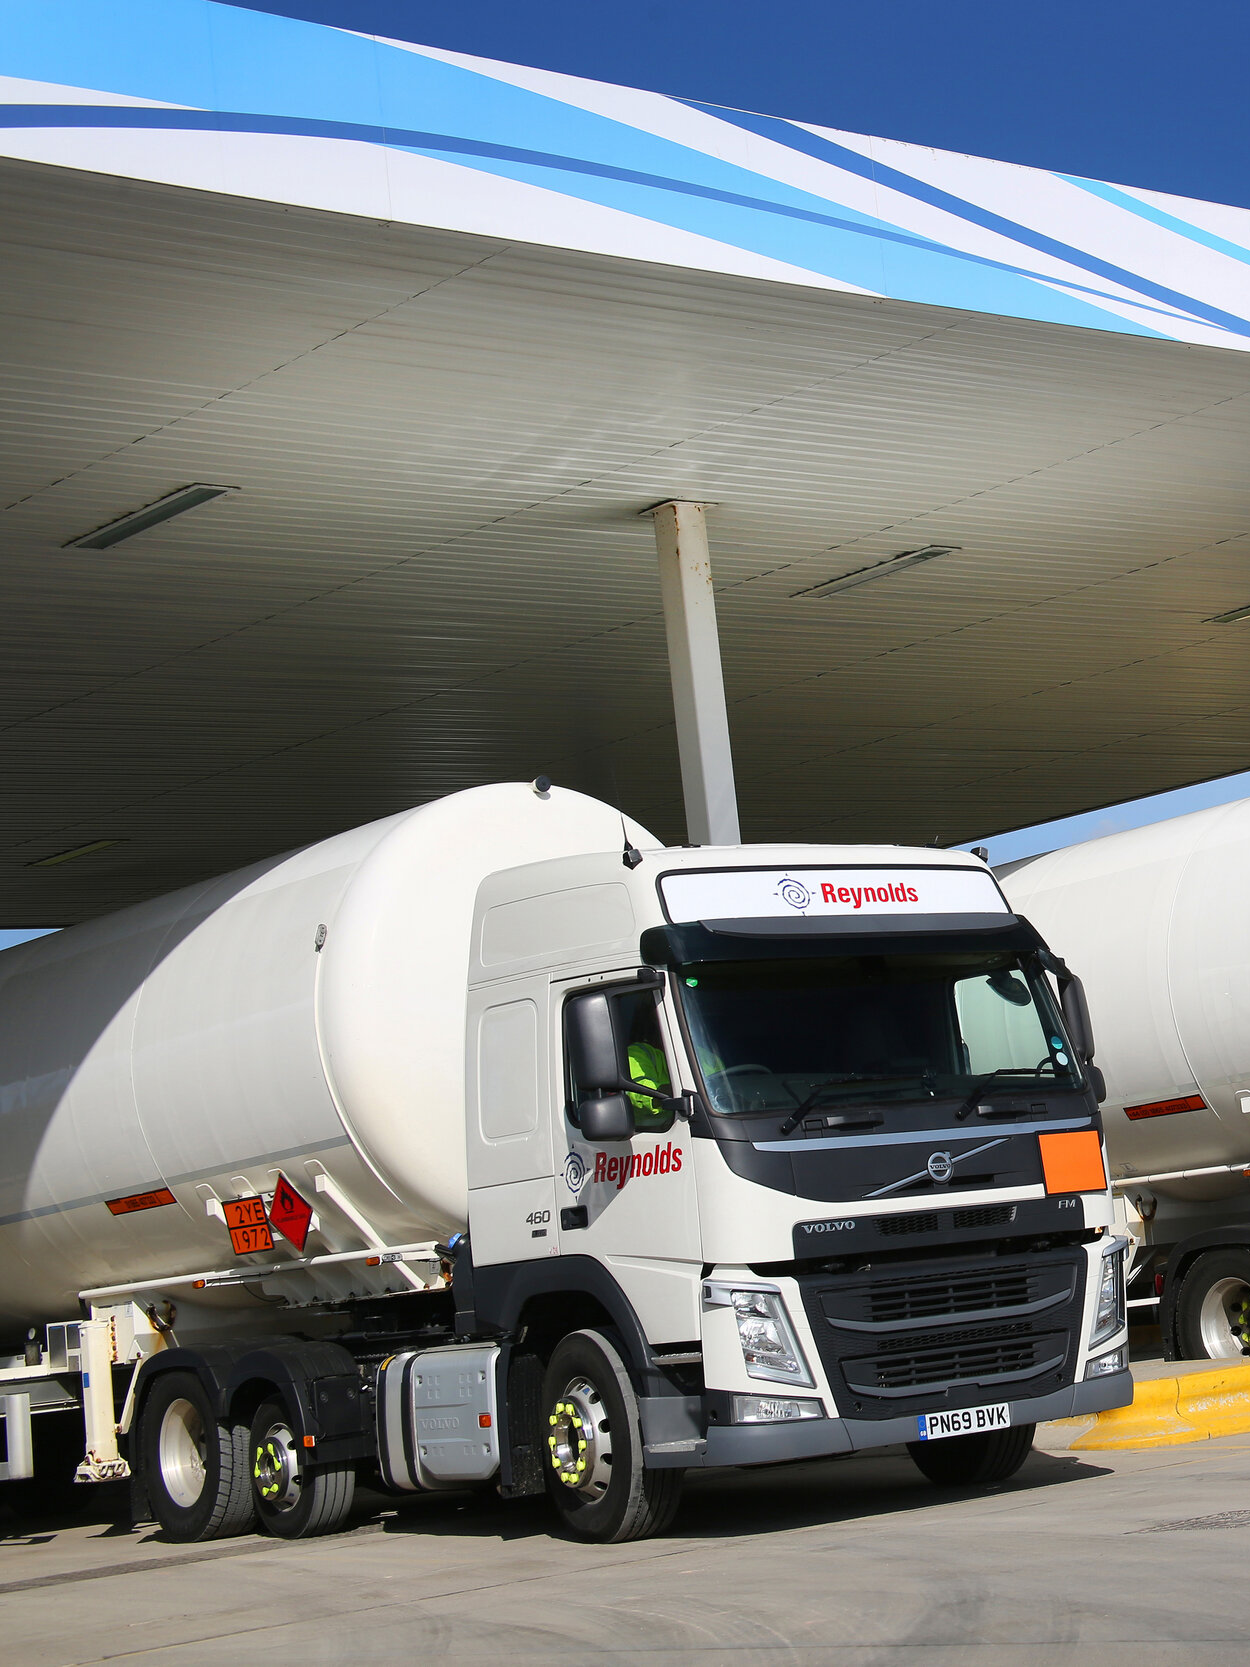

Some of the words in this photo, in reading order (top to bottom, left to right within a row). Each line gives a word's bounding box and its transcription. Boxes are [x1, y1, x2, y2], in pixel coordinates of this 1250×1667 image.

[820, 882, 919, 909] Reynolds
[594, 1141, 683, 1190] Reynolds
[234, 1200, 265, 1224] 2YE
[1058, 1199, 1076, 1209] FM
[526, 1209, 551, 1225] 460
[801, 1220, 856, 1234] VOLVO
[233, 1227, 271, 1251] 1972
[420, 1416, 460, 1431] VOLVO
[928, 1411, 972, 1435] PN69
[976, 1406, 1007, 1428] BVK
